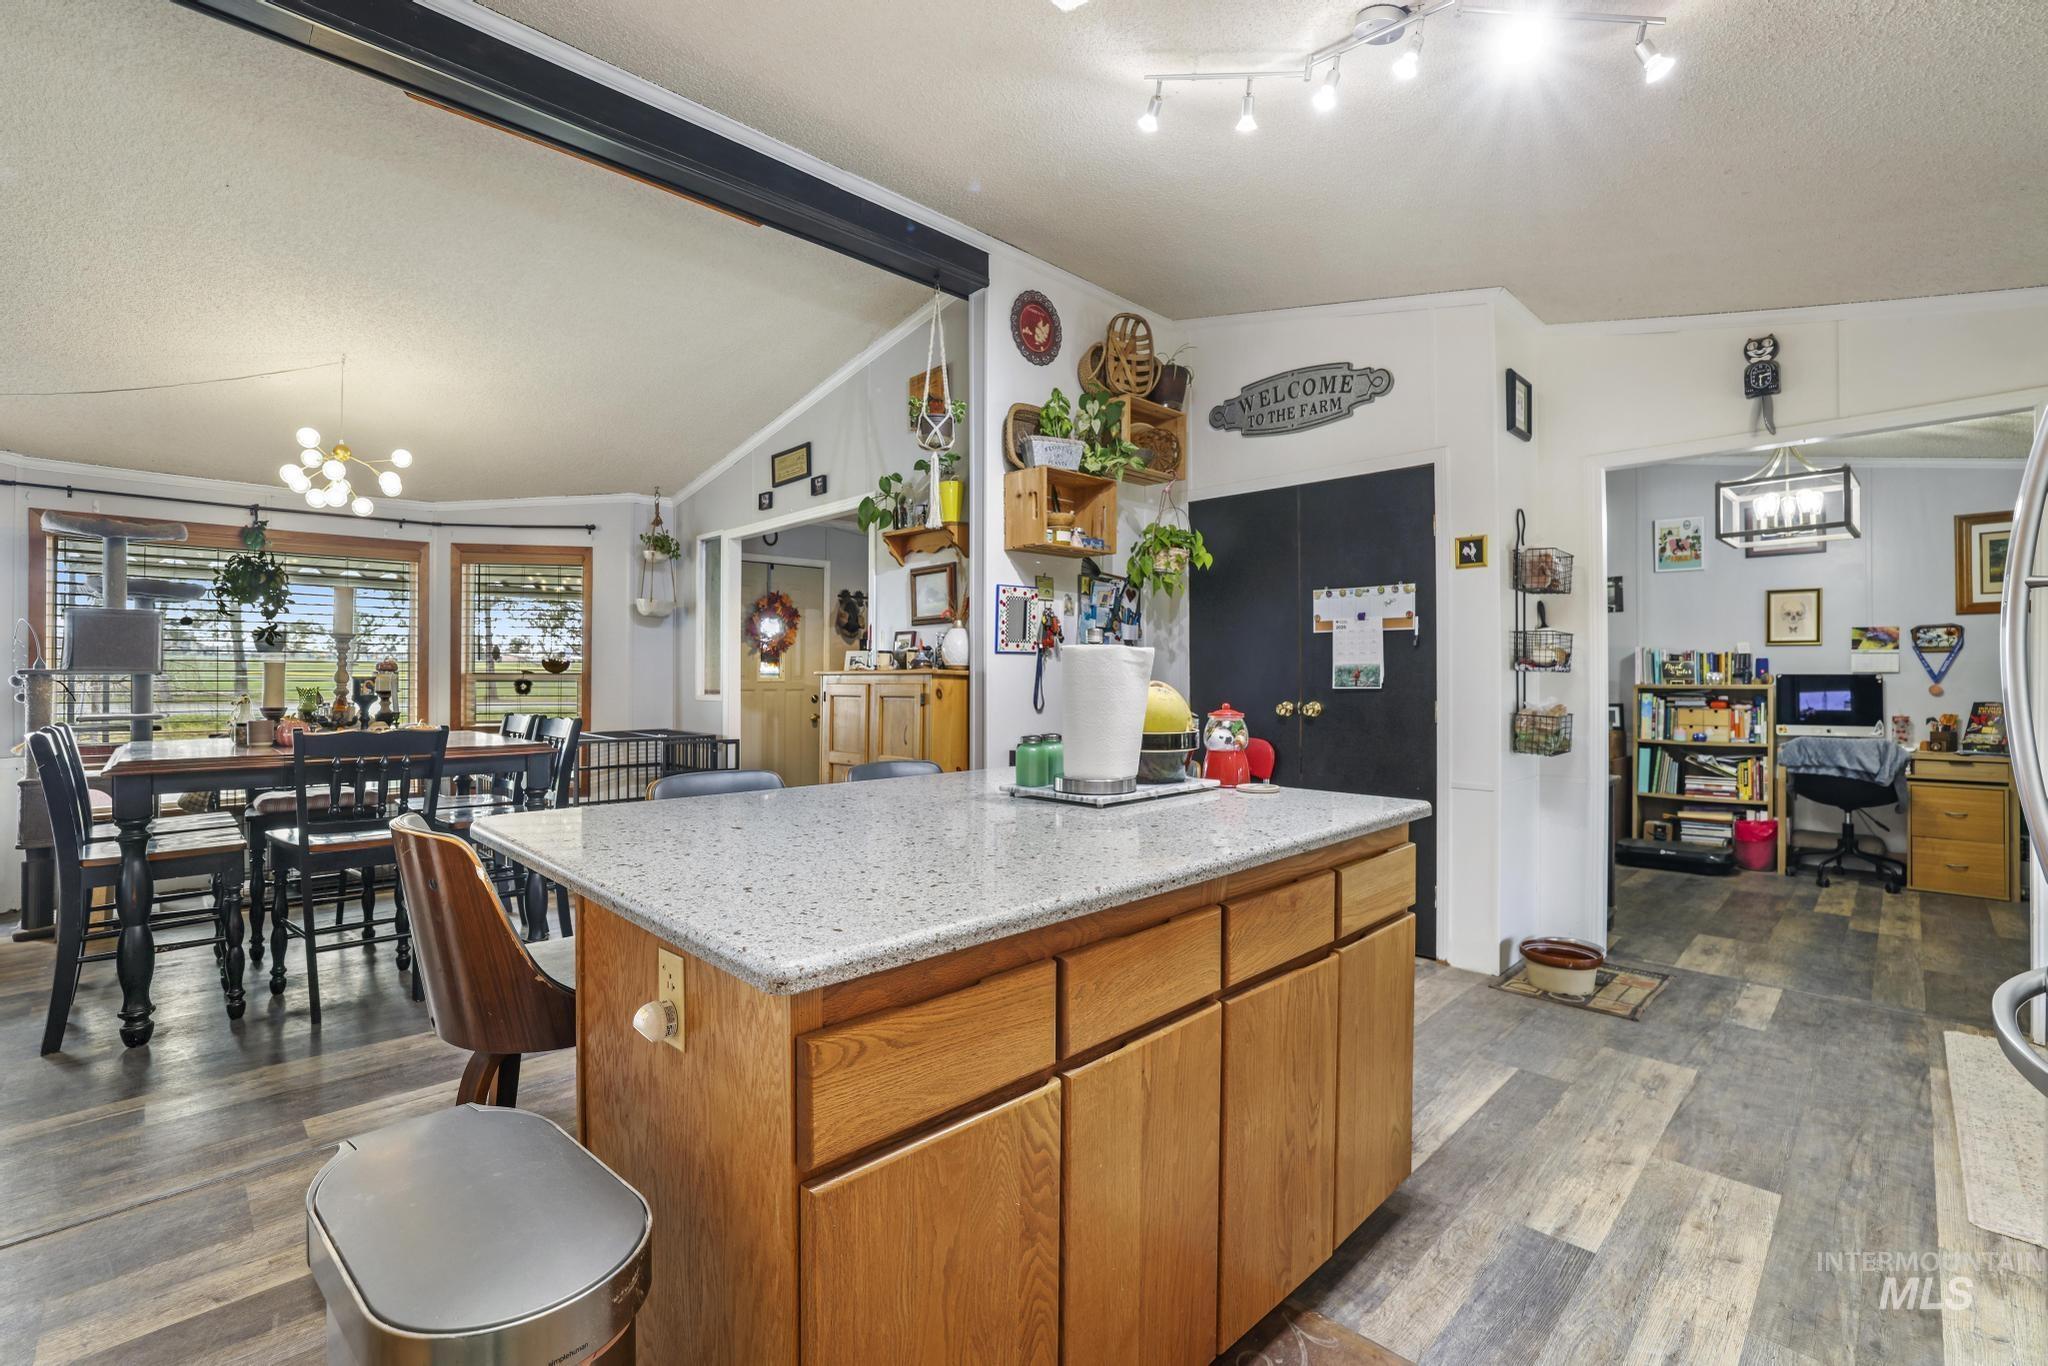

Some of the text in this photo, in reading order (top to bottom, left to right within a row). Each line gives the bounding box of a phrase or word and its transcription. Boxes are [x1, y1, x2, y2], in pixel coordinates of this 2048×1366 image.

[1238, 374, 1354, 415] WELCOME
[1248, 397, 1343, 428] TO THE FARM
